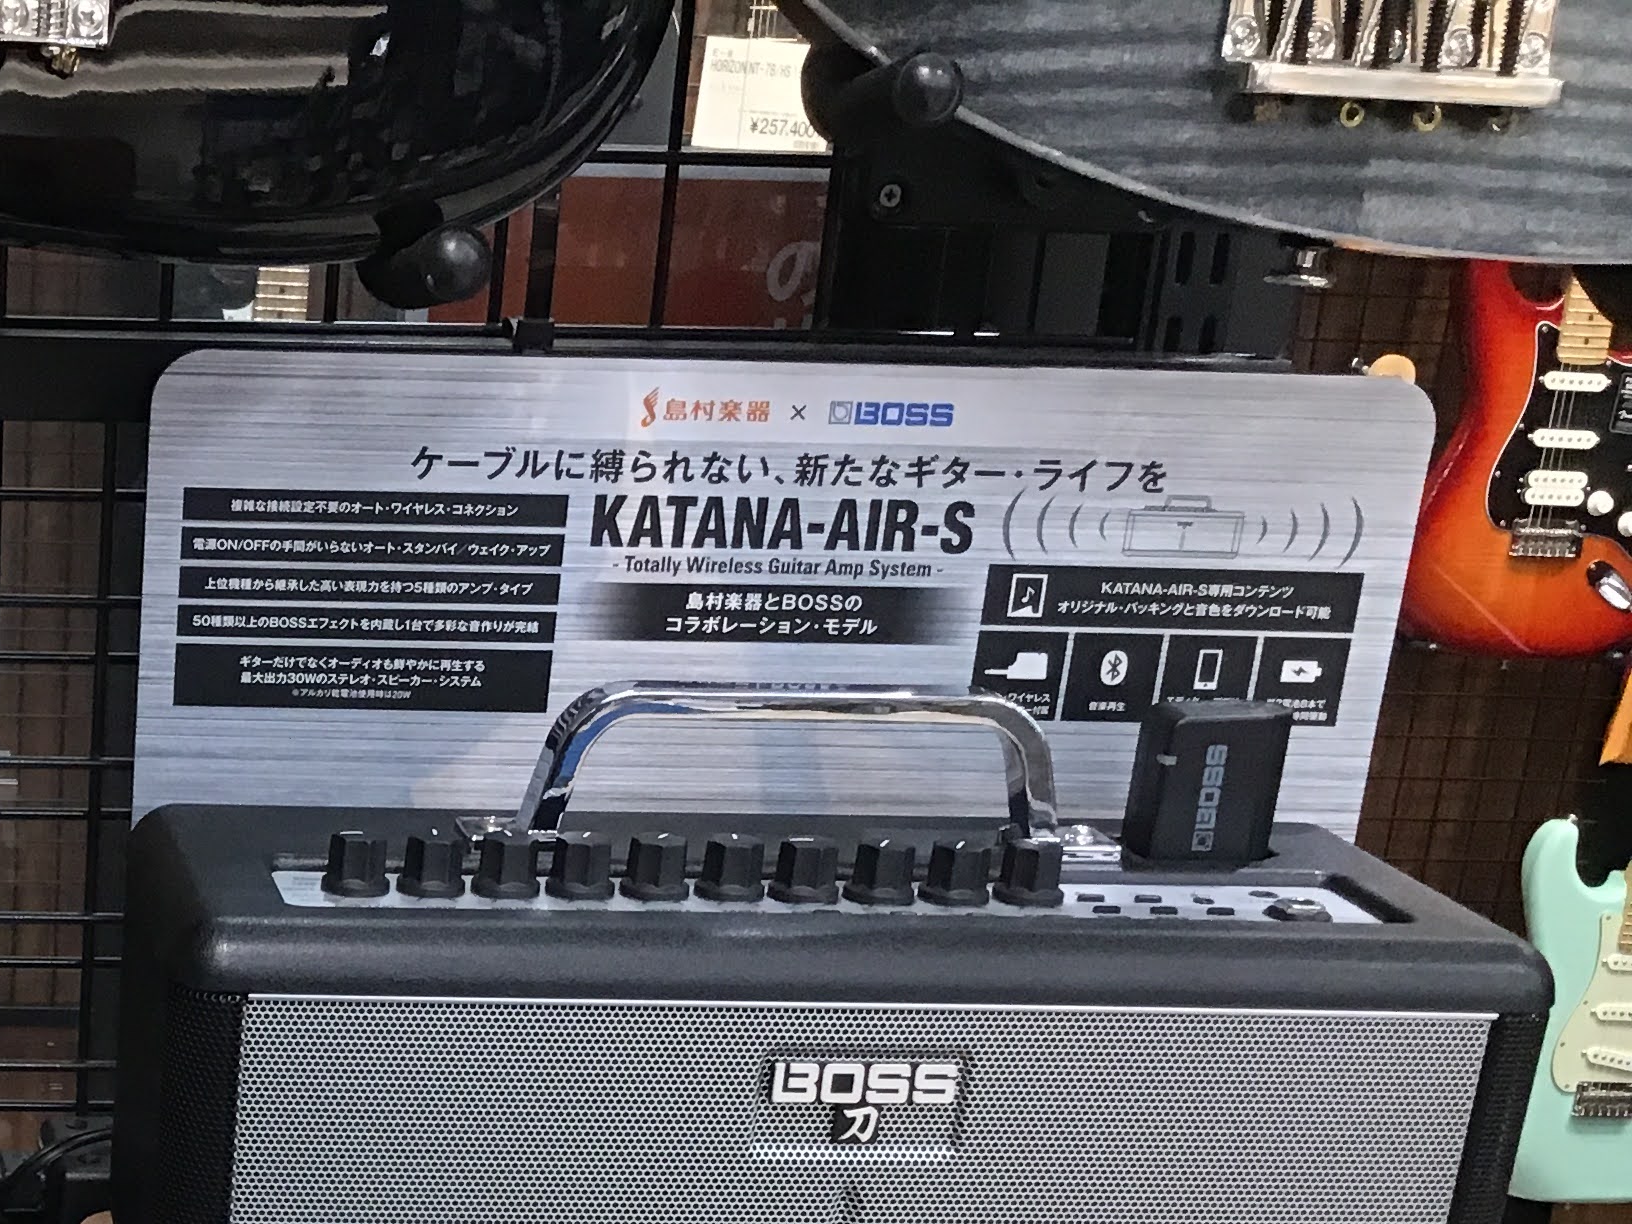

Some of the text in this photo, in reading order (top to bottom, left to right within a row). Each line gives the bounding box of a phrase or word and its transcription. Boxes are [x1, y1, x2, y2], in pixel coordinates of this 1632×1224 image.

[663, 398, 771, 424] 島村楽器
[854, 401, 954, 428] BOSS
[410, 445, 1168, 494] ケーブルに縛られない、新たなギター・ライフを
[590, 494, 976, 555] KATANA-AIR-S
[624, 556, 932, 579] Totally Wireless Guitar Amp System
[686, 591, 863, 612] 島村楽器とBOSSの
[1101, 582, 1295, 599] KATANA-AIR-S専用コンテンツ
[666, 616, 879, 636] コラボレーション・モデル
[239, 655, 486, 673] ギターだけでなくオーディオも鮮やかに再生する
[1195, 744, 1228, 830] BOSS
[772, 1062, 958, 1104] BOSS
[838, 1107, 878, 1143] 刀
